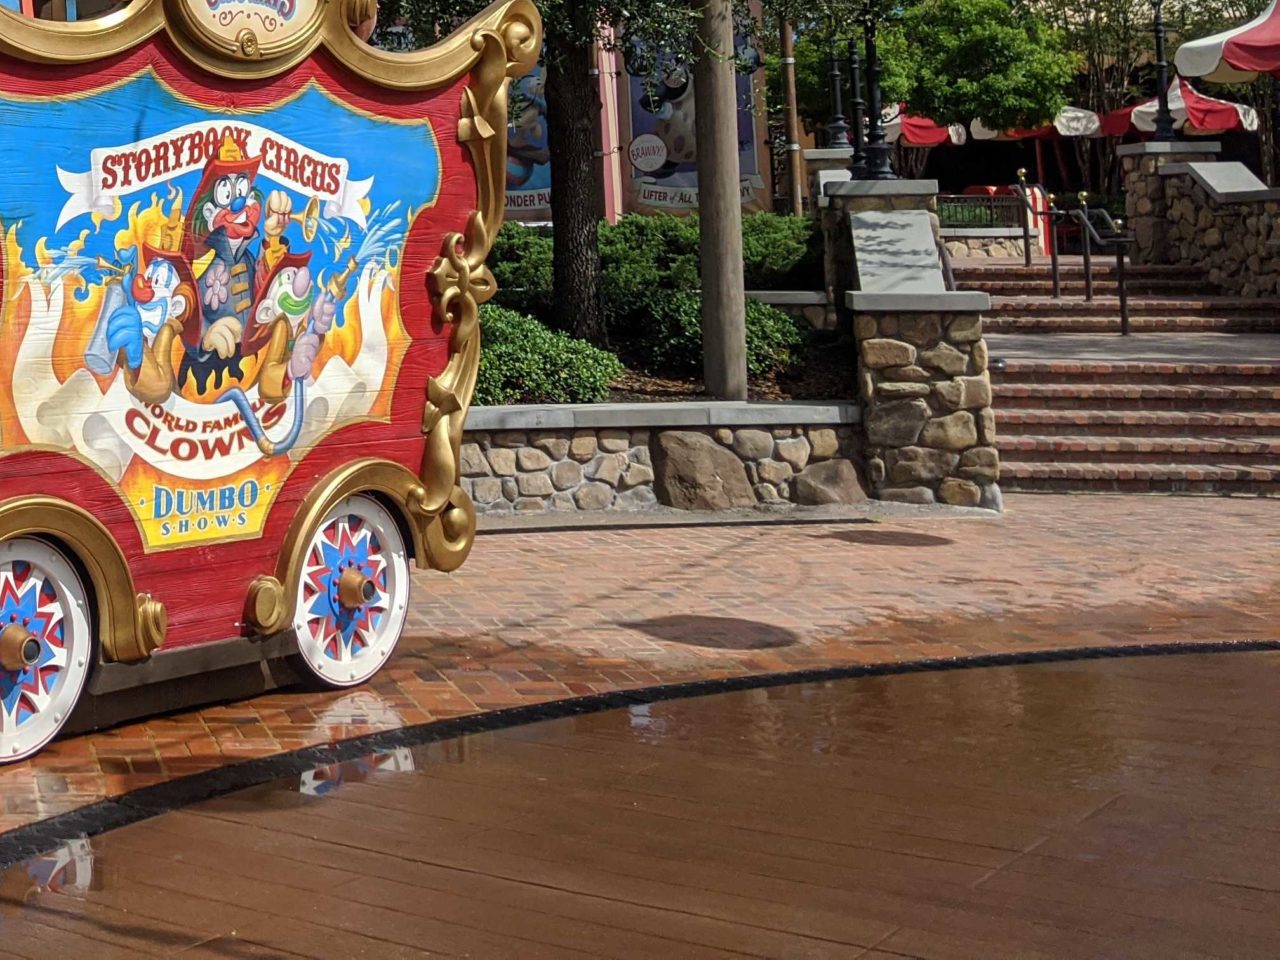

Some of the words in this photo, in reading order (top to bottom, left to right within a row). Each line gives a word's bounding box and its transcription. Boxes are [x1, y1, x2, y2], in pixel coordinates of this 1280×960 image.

[260, 137, 341, 195] CIRCUS
[504, 194, 535, 208] ONDER
[642, 190, 668, 201] LIFTER
[678, 192, 693, 204] ALL
[142, 401, 198, 432] ORLD
[153, 480, 258, 519] DUMBO
